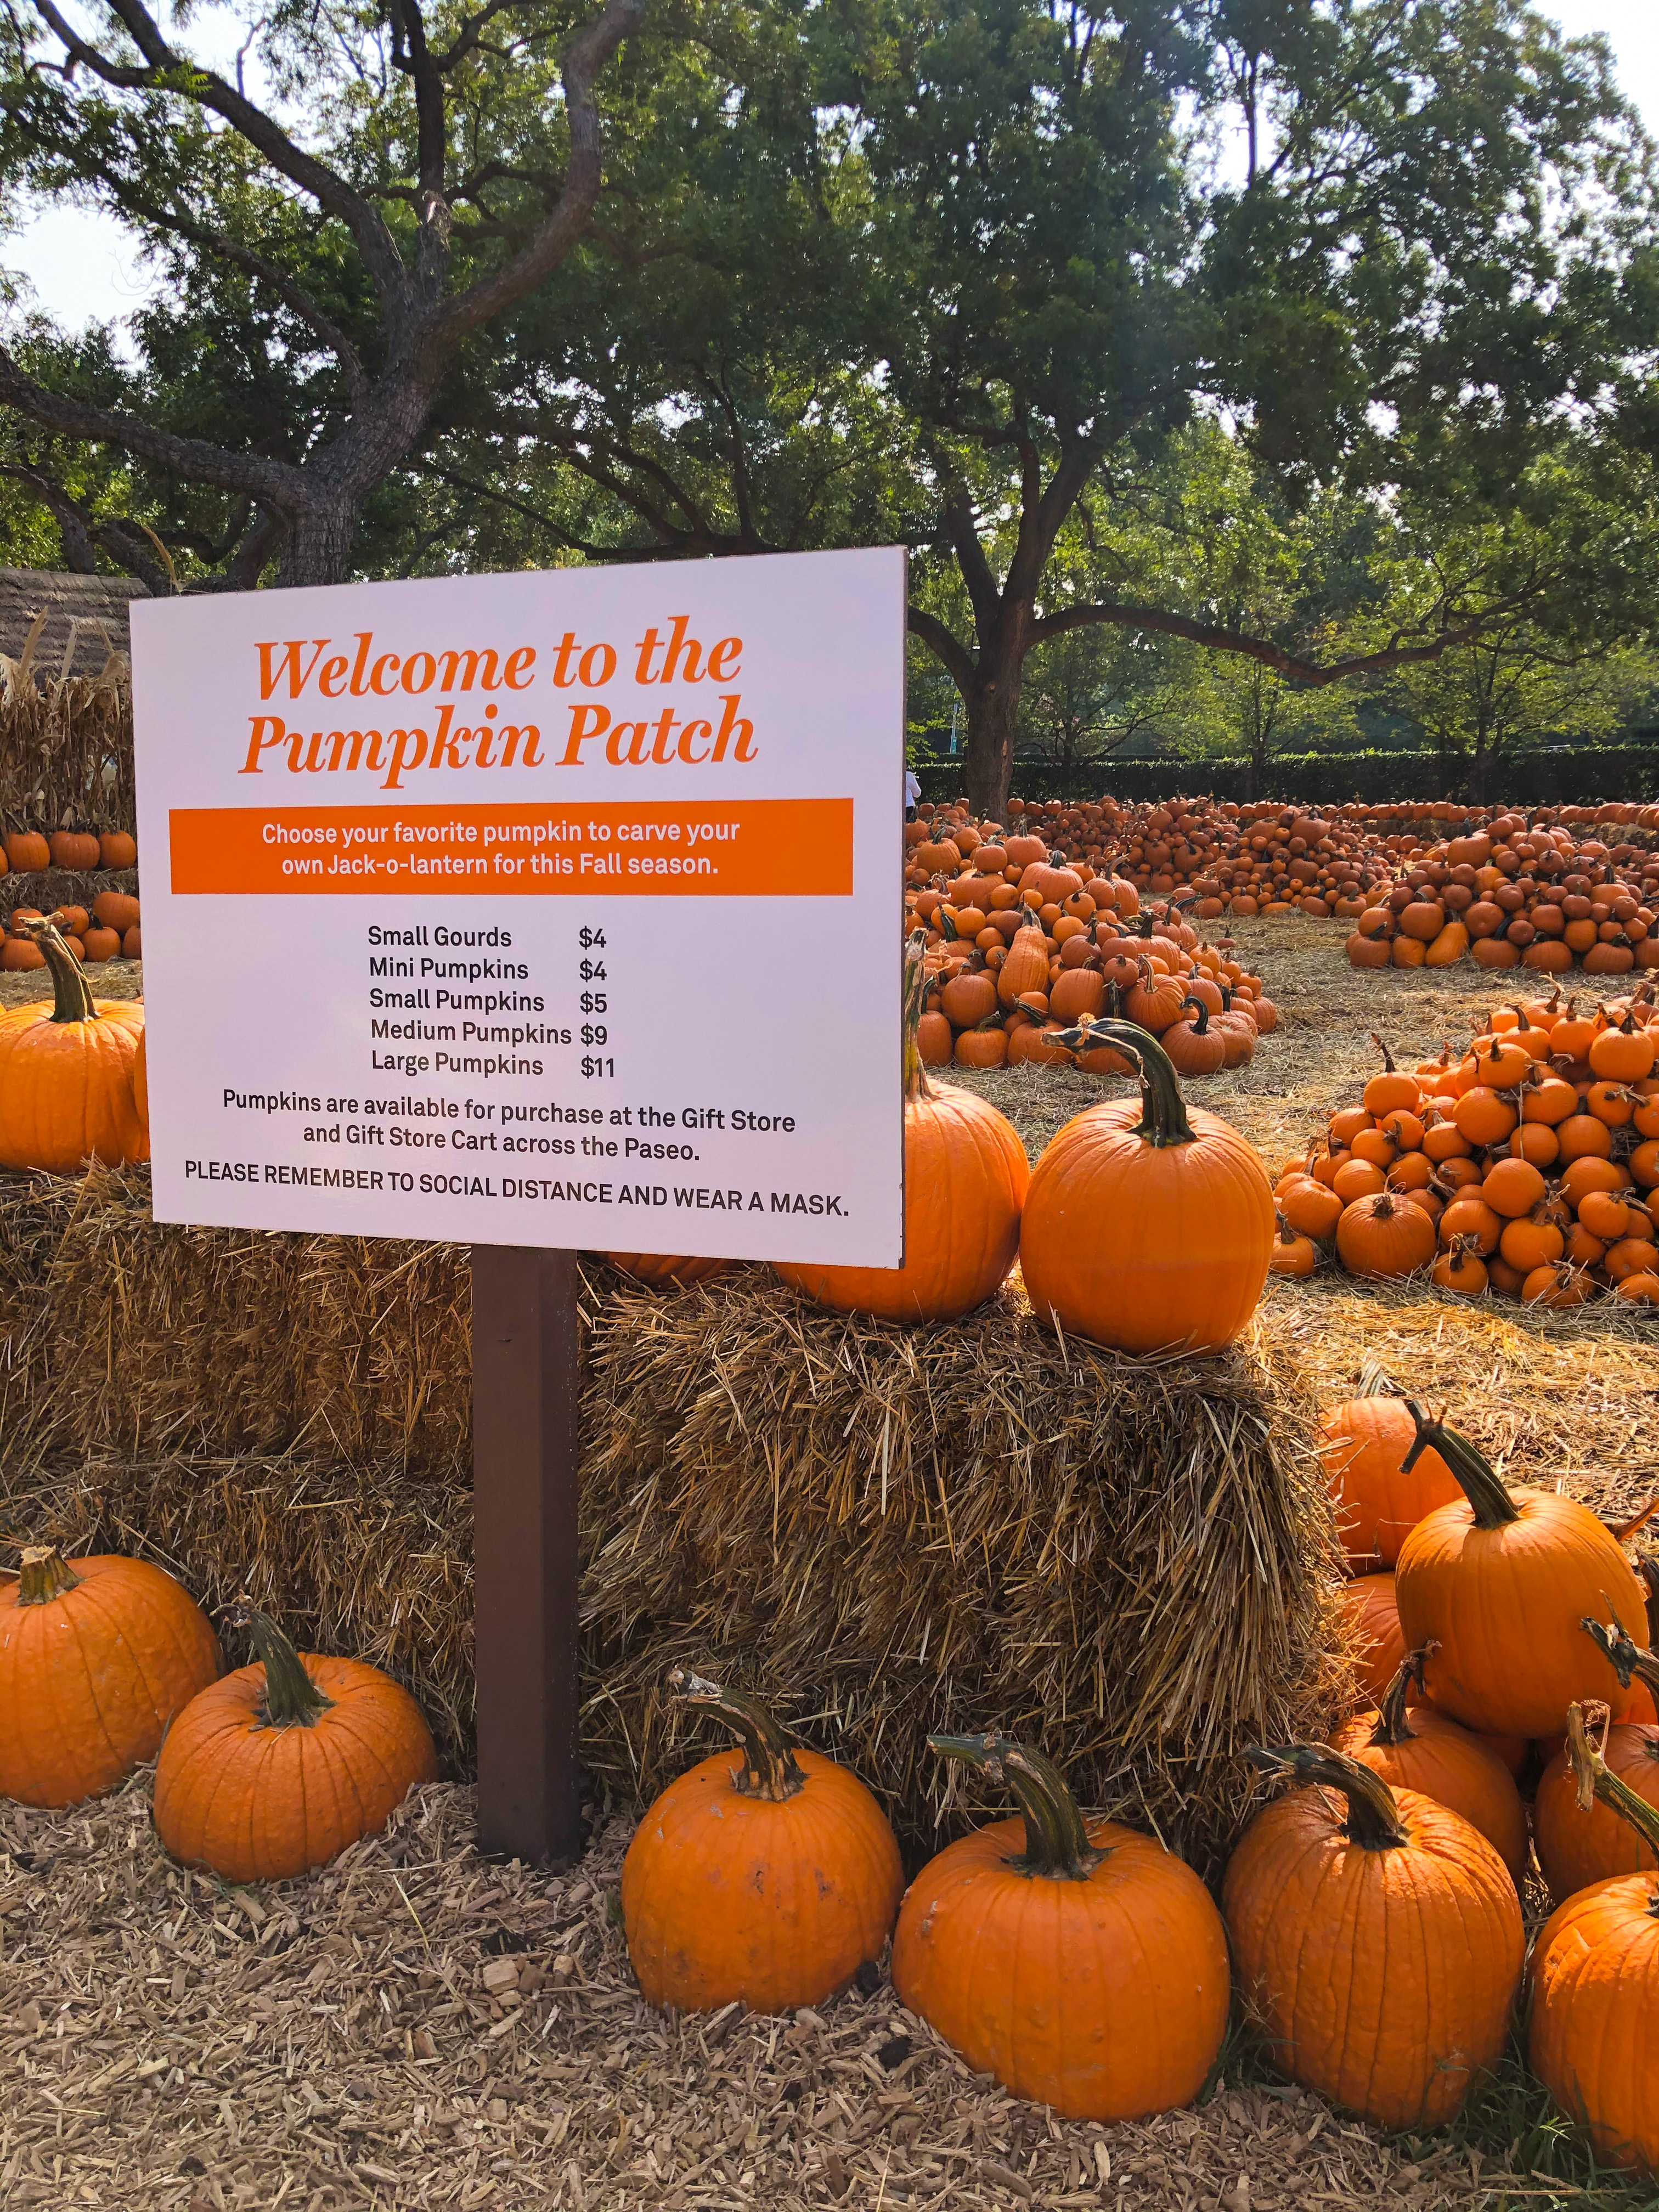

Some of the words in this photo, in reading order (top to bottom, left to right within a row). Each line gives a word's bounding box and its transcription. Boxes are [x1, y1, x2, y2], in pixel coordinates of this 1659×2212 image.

[254, 632, 536, 700] Welcome
[552, 633, 617, 688] to
[635, 615, 743, 685] the
[238, 703, 545, 789] Pumpkin
[555, 695, 758, 766] Patch
[262, 823, 337, 844] Choose
[341, 827, 389, 849] your
[393, 821, 478, 843] favorite
[483, 820, 582, 847] pumpkin
[587, 821, 611, 842] to
[617, 823, 681, 842] carve
[686, 823, 741, 847] your
[281, 859, 323, 874] own
[327, 853, 488, 874] Jack-o-lantern
[493, 853, 526, 874] for
[529, 853, 574, 874] this
[580, 852, 622, 874] Fall
[628, 857, 718, 874] season.
[368, 926, 429, 946] Small
[434, 926, 512, 947] Gourds
[579, 925, 607, 951] $4
[370, 957, 414, 977] Mini
[421, 957, 529, 984] Pumpkins
[579, 958, 607, 983] $4
[370, 988, 431, 1009] Small
[436, 989, 545, 1015] Pumpkins
[579, 990, 607, 1015] $5
[371, 1019, 456, 1041] Medium
[462, 1022, 572, 1048] Pumpkins
[580, 1022, 607, 1047] $9
[372, 1049, 430, 1077] Large
[436, 1052, 544, 1079] Pumpkins
[580, 1054, 614, 1079] $11
[223, 1088, 321, 1115] Pumpkins
[326, 1098, 359, 1114] are
[364, 1096, 459, 1118] available
[464, 1098, 495, 1120] for
[501, 1102, 603, 1125] purchase
[609, 1106, 633, 1126] at
[637, 1106, 676, 1127] the
[682, 1108, 725, 1130] Gift
[731, 1109, 795, 1133] Store
[303, 1124, 340, 1143] and
[346, 1124, 385, 1146] Gift
[389, 1126, 446, 1148] Store
[452, 1130, 498, 1151] Cart
[503, 1137, 575, 1155] across
[580, 1136, 618, 1157] the
[625, 1137, 699, 1161] Paseo.
[185, 1160, 259, 1182] PLEASE
[264, 1165, 383, 1190] REMEMBER
[387, 1172, 414, 1192] TO
[419, 1173, 498, 1197] SOCIAL
[503, 1178, 613, 1203] DISTANCE
[618, 1184, 668, 1206] AND
[673, 1187, 742, 1211] WEAR
[748, 1192, 764, 1212] A
[771, 1192, 849, 1216] MASK.
